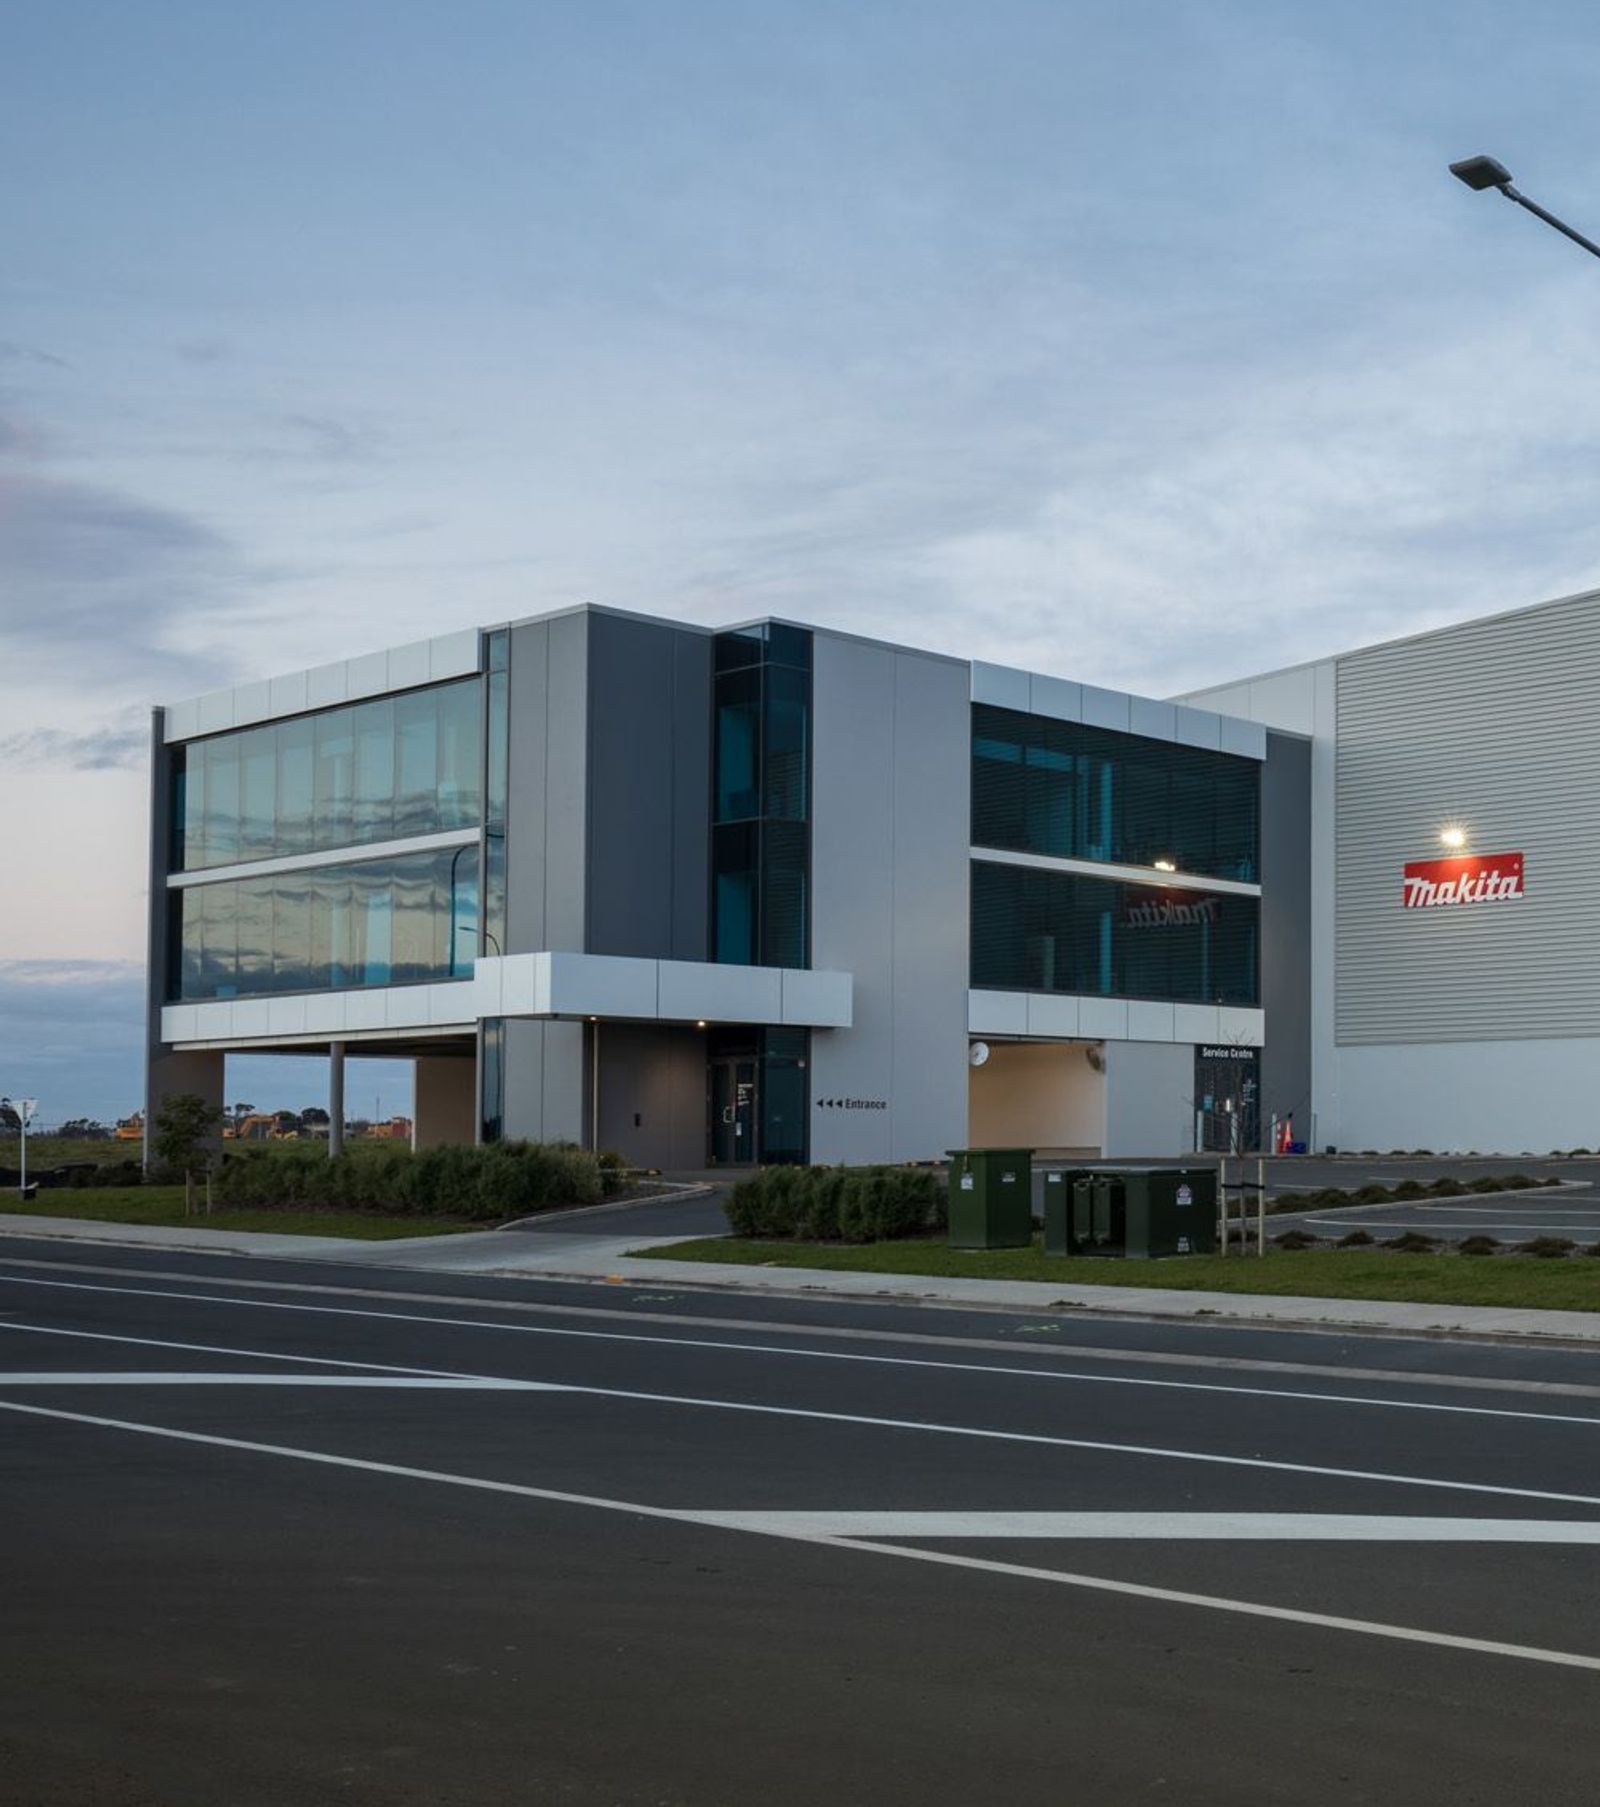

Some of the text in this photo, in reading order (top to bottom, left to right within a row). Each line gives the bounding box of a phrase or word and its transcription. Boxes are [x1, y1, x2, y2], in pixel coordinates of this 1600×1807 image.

[1202, 1047, 1254, 1059] Service Centre
[845, 1098, 887, 1110] Entrance
